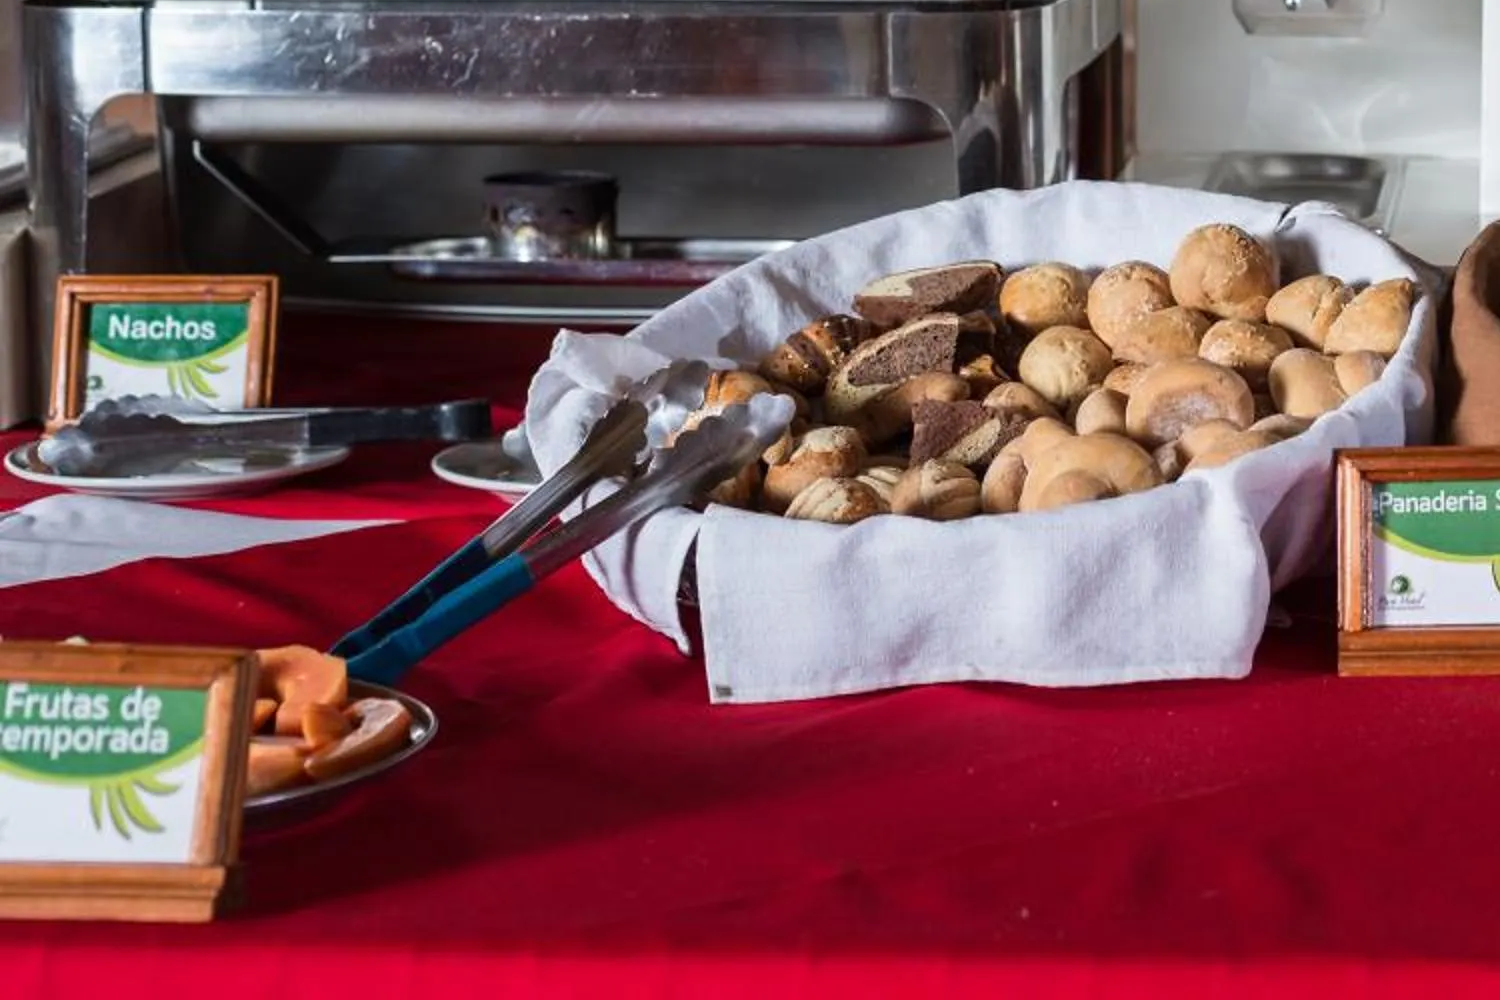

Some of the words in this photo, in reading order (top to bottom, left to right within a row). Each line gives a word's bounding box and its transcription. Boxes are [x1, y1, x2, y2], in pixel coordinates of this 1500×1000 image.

[108, 313, 216, 339] Nachos
[1380, 490, 1487, 514] Panaderia
[4, 682, 110, 720] Frutas
[120, 685, 163, 721] de
[0, 719, 170, 761] emporada
